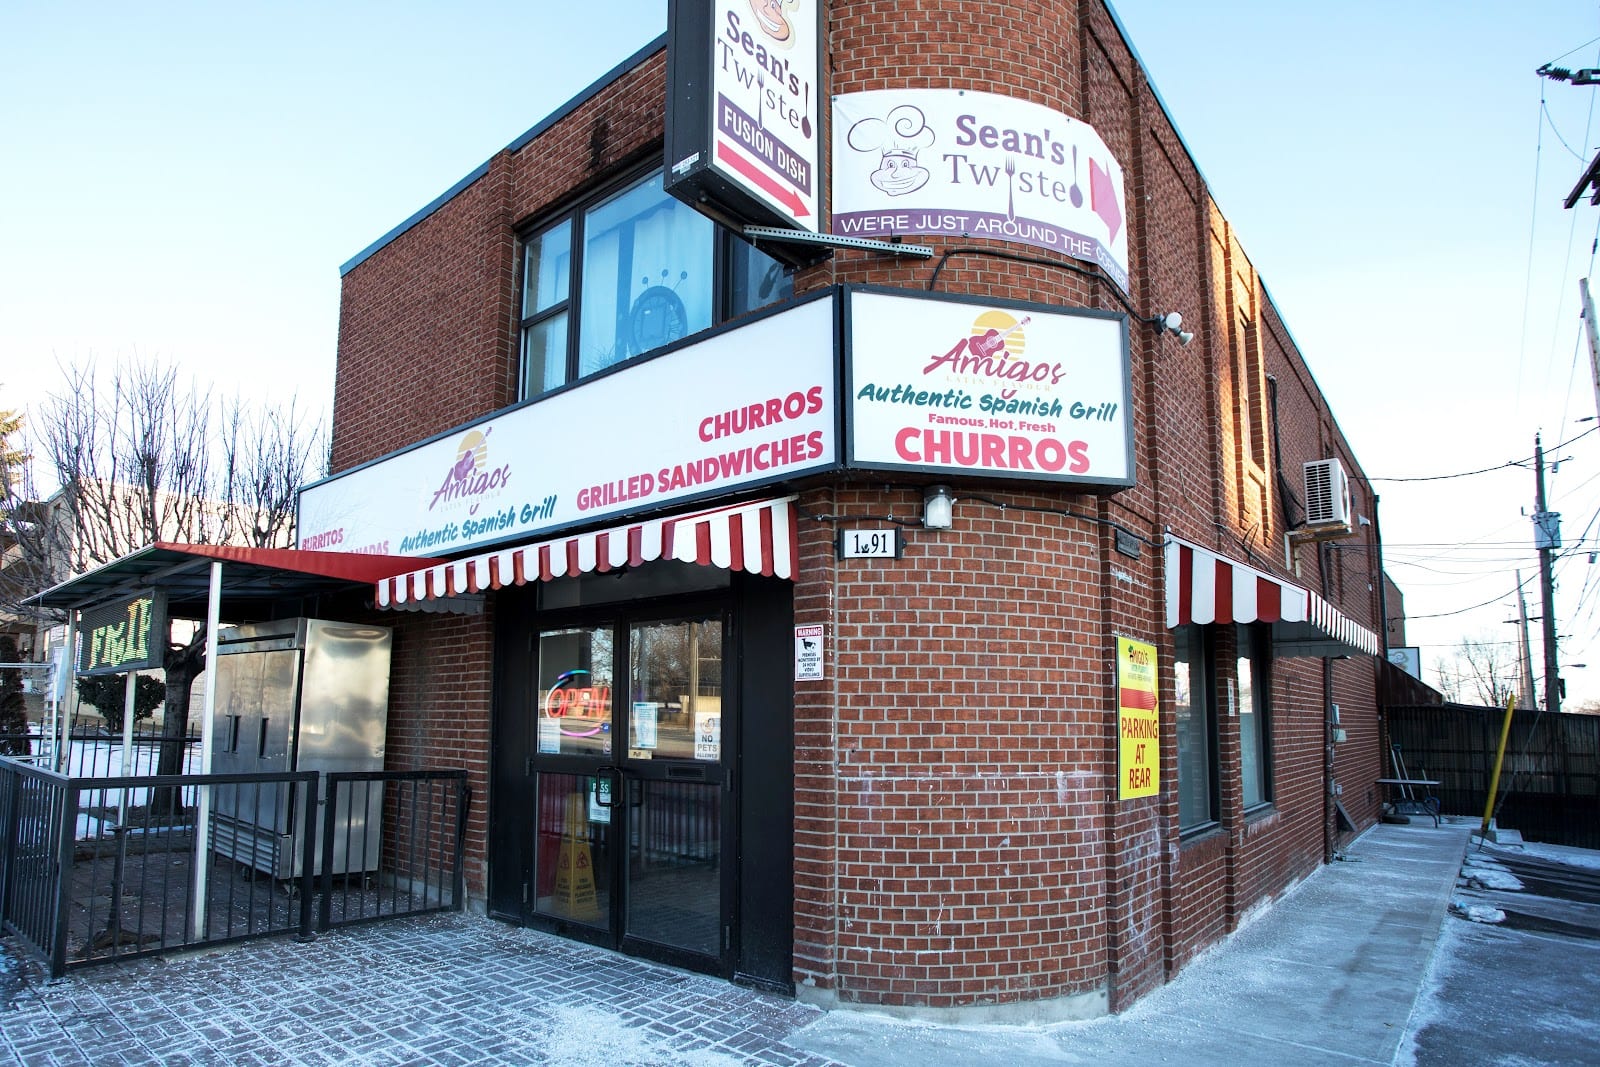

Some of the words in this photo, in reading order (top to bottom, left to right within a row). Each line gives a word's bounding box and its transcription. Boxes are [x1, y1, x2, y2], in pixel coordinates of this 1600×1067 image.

[726, 10, 800, 97] Sean's
[724, 105, 774, 161] FUSION
[777, 147, 807, 187] DISH
[956, 113, 1065, 165] Sean's
[841, 215, 909, 233] WE'RE
[915, 215, 970, 231] JUST
[974, 216, 1057, 244] AROUND
[1061, 234, 1092, 256] THE
[923, 337, 1066, 400] Amigos
[698, 386, 823, 442] CHURROS
[857, 383, 973, 410] Authentic
[979, 394, 1063, 418] Spanish
[1069, 401, 1119, 422] Grill
[1018, 420, 1056, 433] Fresh
[895, 426, 1091, 474] CHURROS
[428, 463, 512, 516] Amigos
[576, 473, 655, 511] GRILLED
[657, 430, 824, 493] SANDWICHES
[302, 527, 344, 551] BURRITOS
[399, 522, 459, 553] Authentic
[462, 505, 516, 540] Spanish
[520, 494, 557, 524] Grill
[549, 687, 609, 719] OPEN
[697, 744, 718, 752] PETS
[701, 734, 713, 743] NO
[1121, 717, 1158, 739] PARKING
[1135, 743, 1146, 765] AT
[592, 782, 609, 793] PSS
[1129, 767, 1151, 790] REAR
